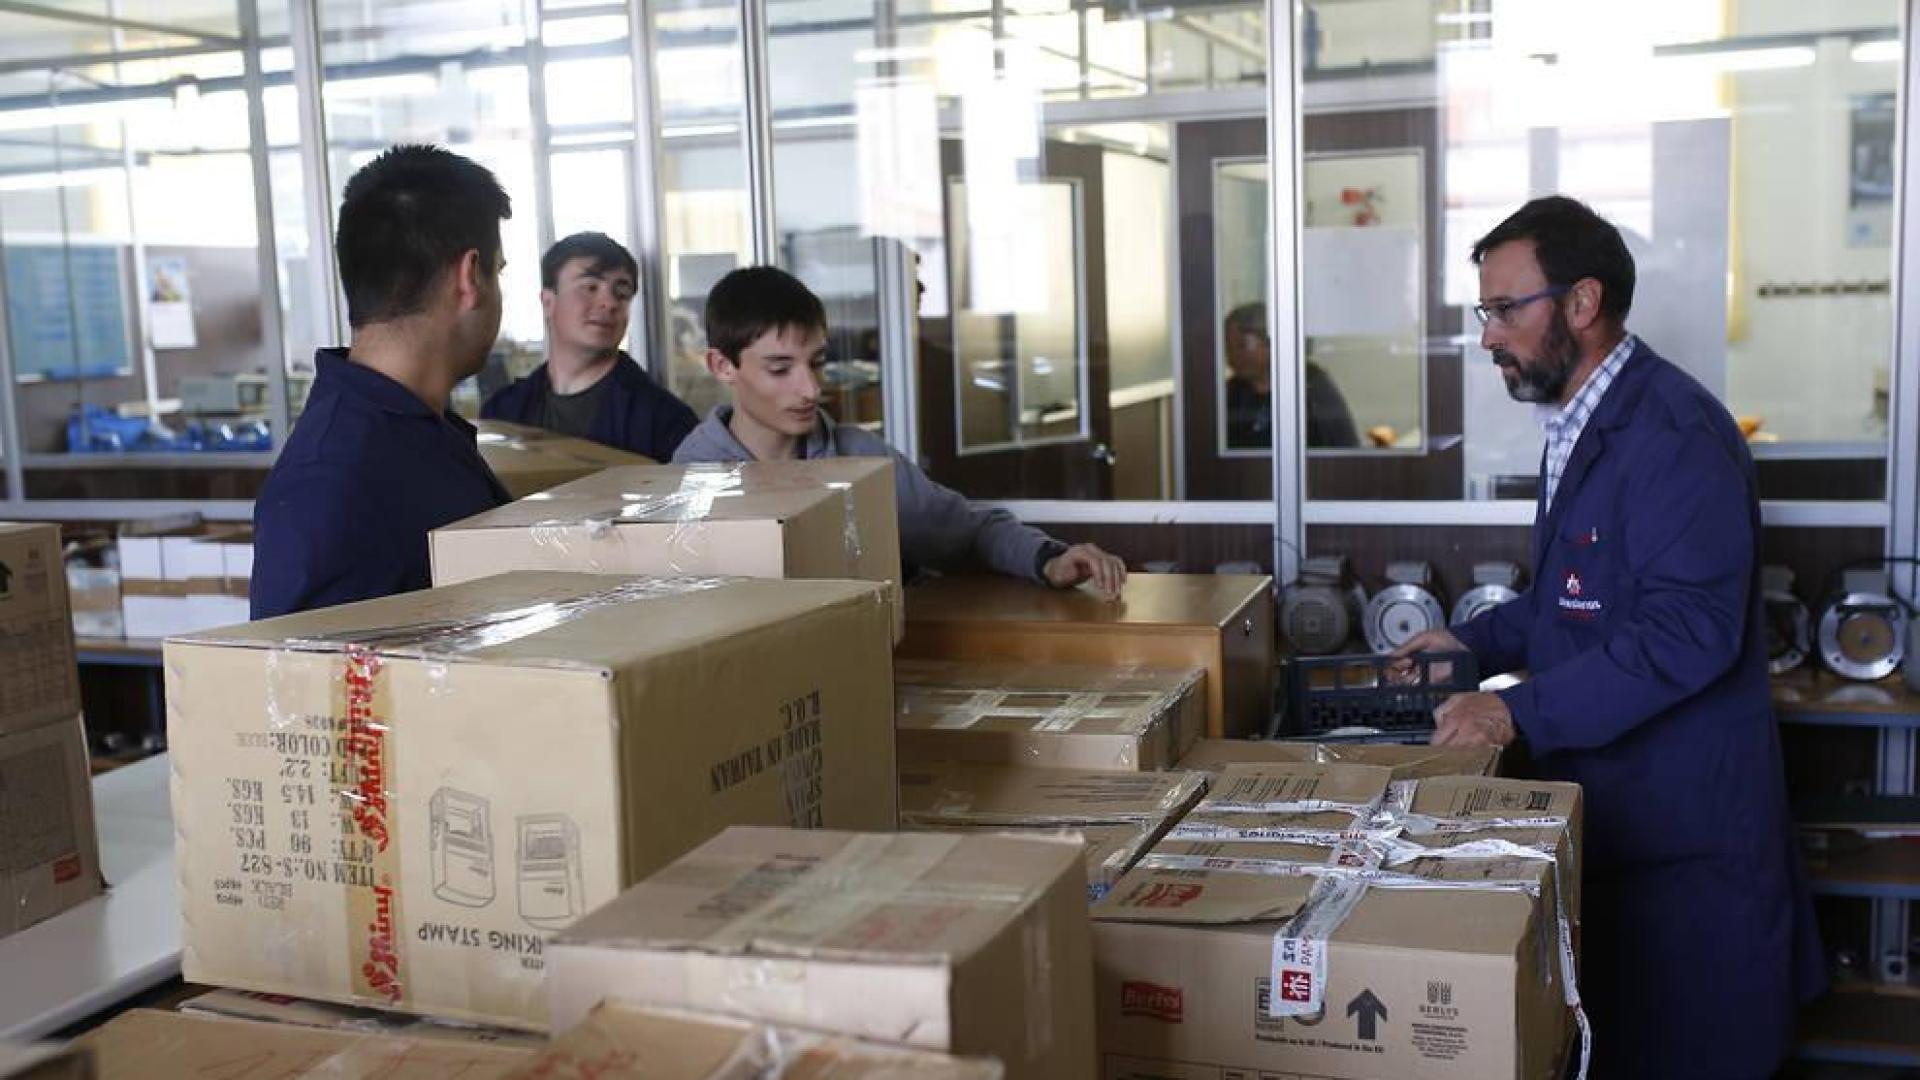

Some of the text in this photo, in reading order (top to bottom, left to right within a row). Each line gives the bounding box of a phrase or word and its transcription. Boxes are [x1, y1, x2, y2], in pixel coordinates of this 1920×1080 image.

[269, 732, 330, 756] COLOR:
[786, 722, 821, 758] MADE
[767, 738, 781, 766] IN
[710, 746, 763, 794] TAIWAN
[225, 777, 263, 800] KGS.
[281, 784, 315, 804] 14.5
[226, 803, 265, 825] KGS.
[290, 810, 309, 830] 13
[229, 827, 265, 850] PCS.
[334, 864, 375, 887] ITEM
[418, 922, 480, 947] STAMP
